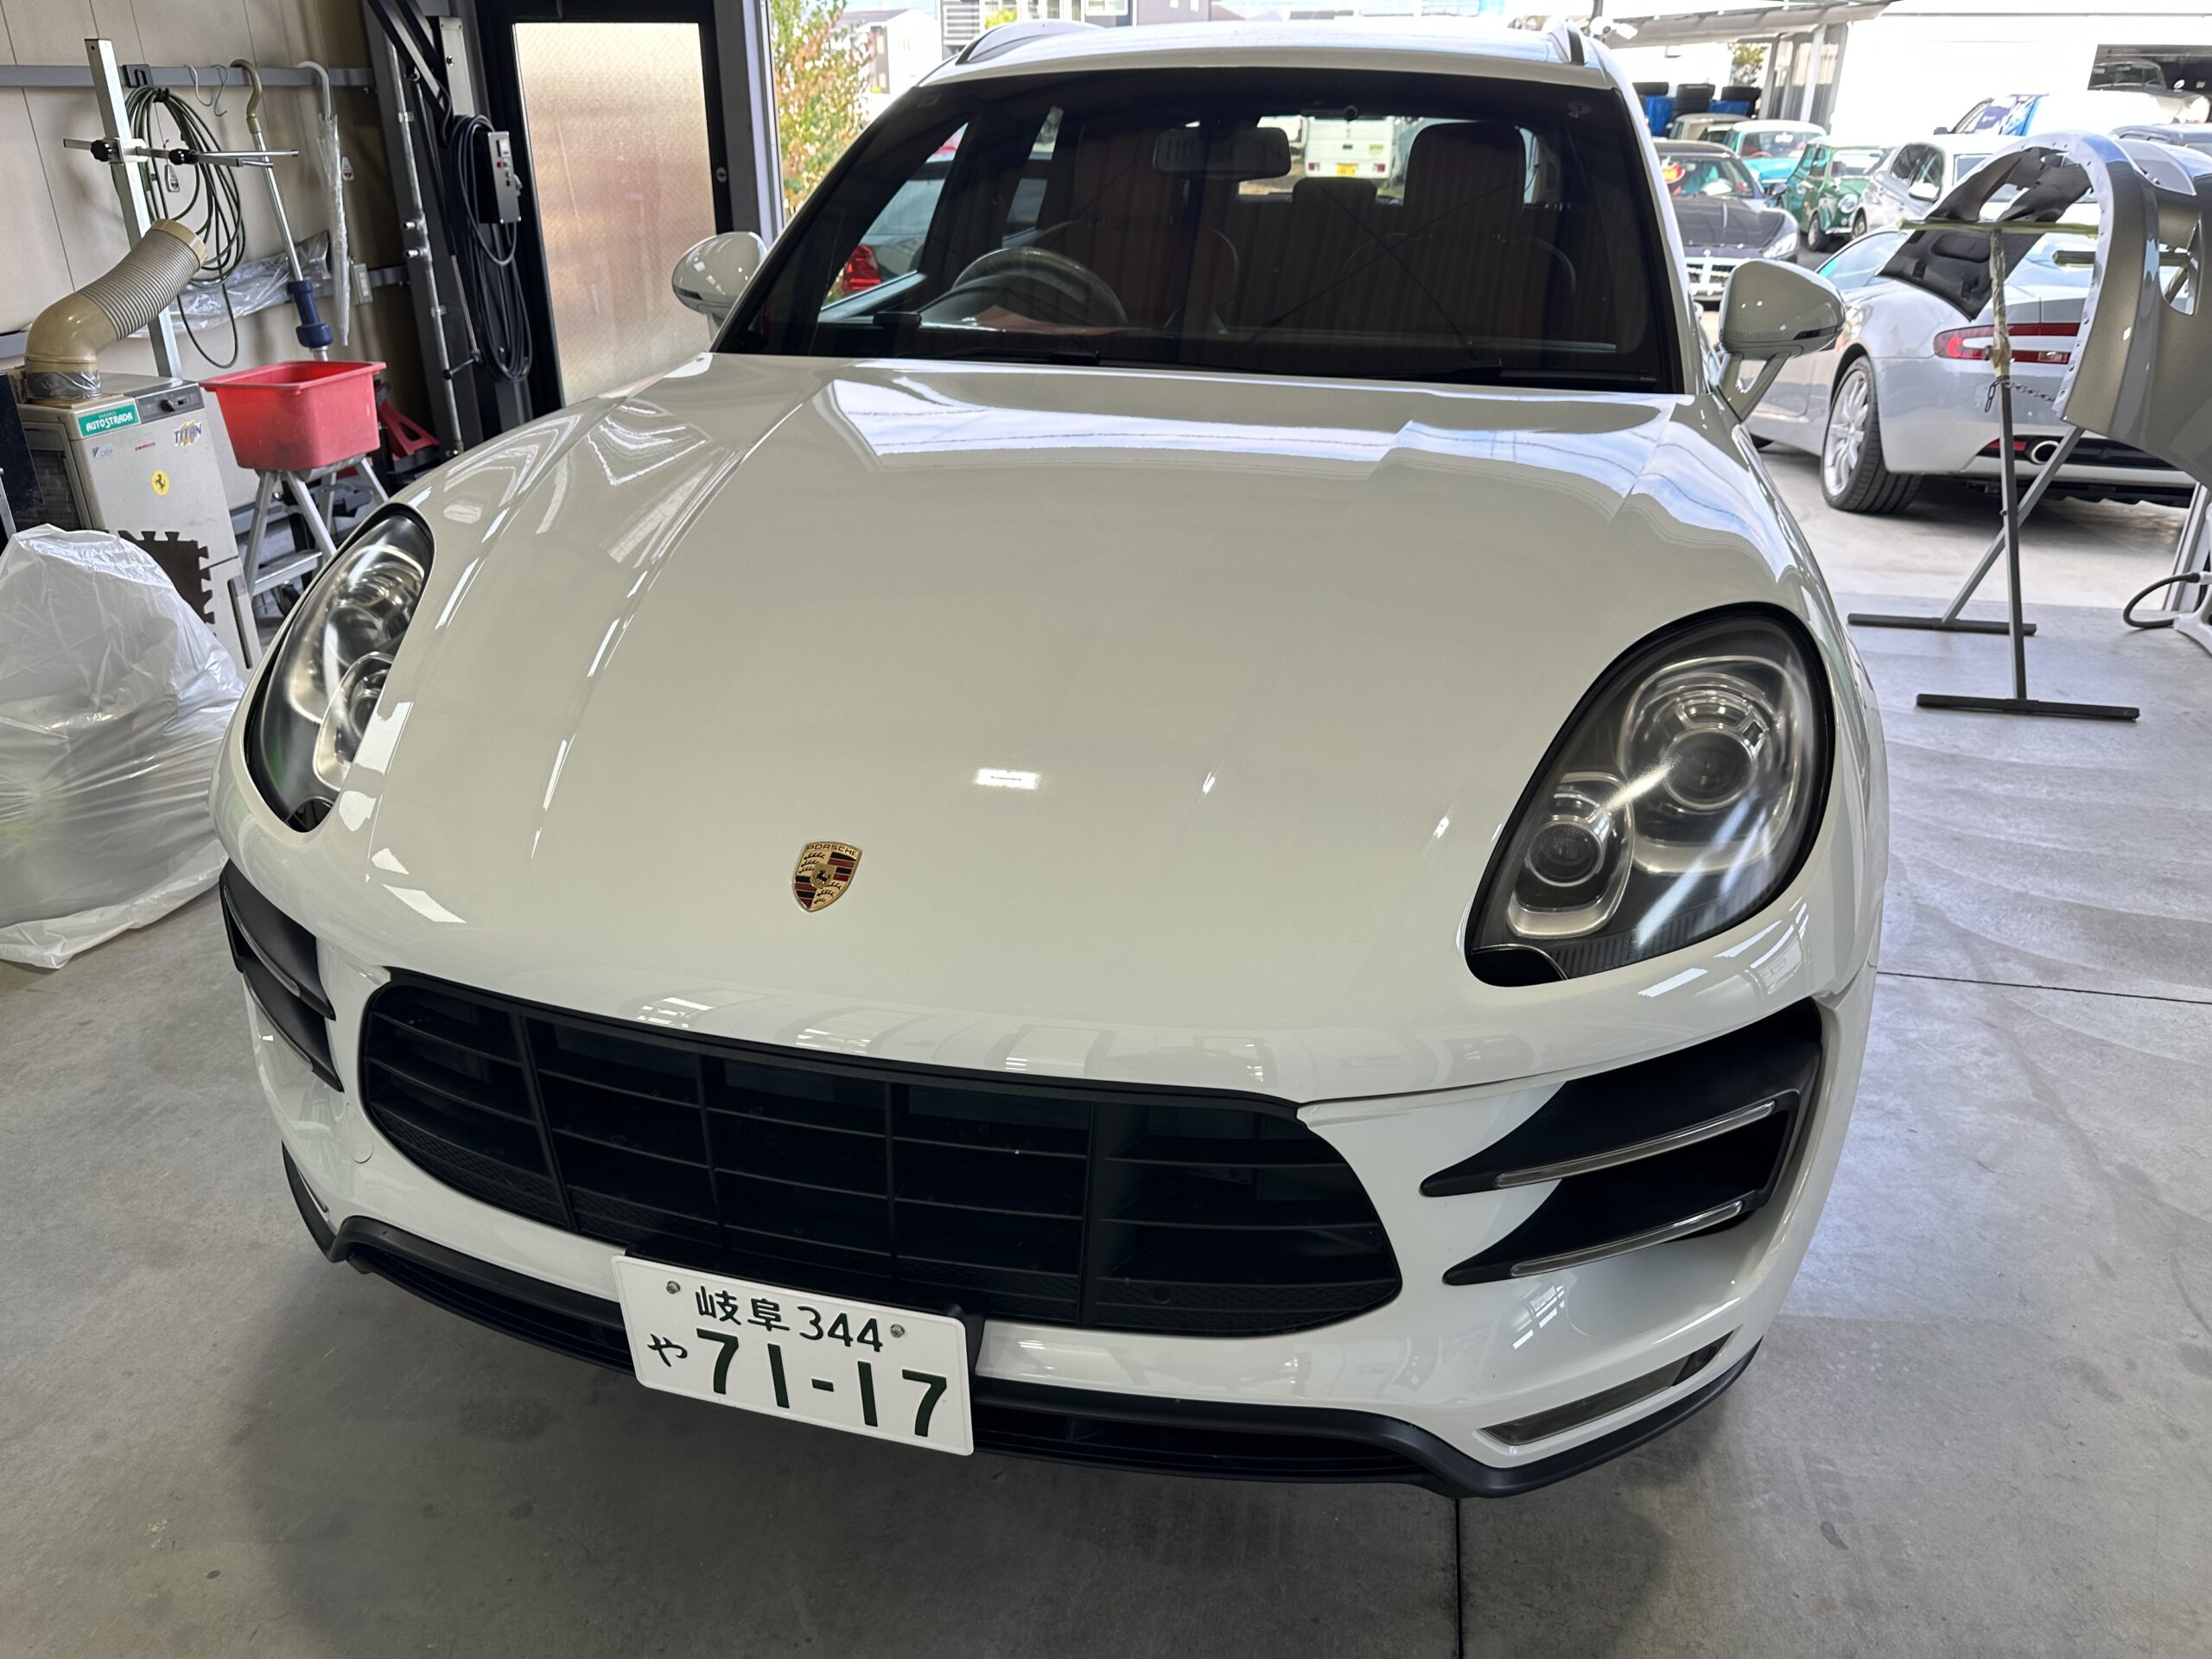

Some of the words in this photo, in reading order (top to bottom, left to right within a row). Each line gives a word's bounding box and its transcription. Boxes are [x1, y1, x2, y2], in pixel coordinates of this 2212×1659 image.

[86, 412, 133, 432] AUTOSTRADA
[174, 423, 202, 443] TITAN
[806, 843, 859, 857] PORSCHE
[695, 1286, 791, 1332] 岐阜
[798, 1306, 883, 1352] 344
[647, 1333, 688, 1367] や
[696, 1328, 947, 1438] 71-17
